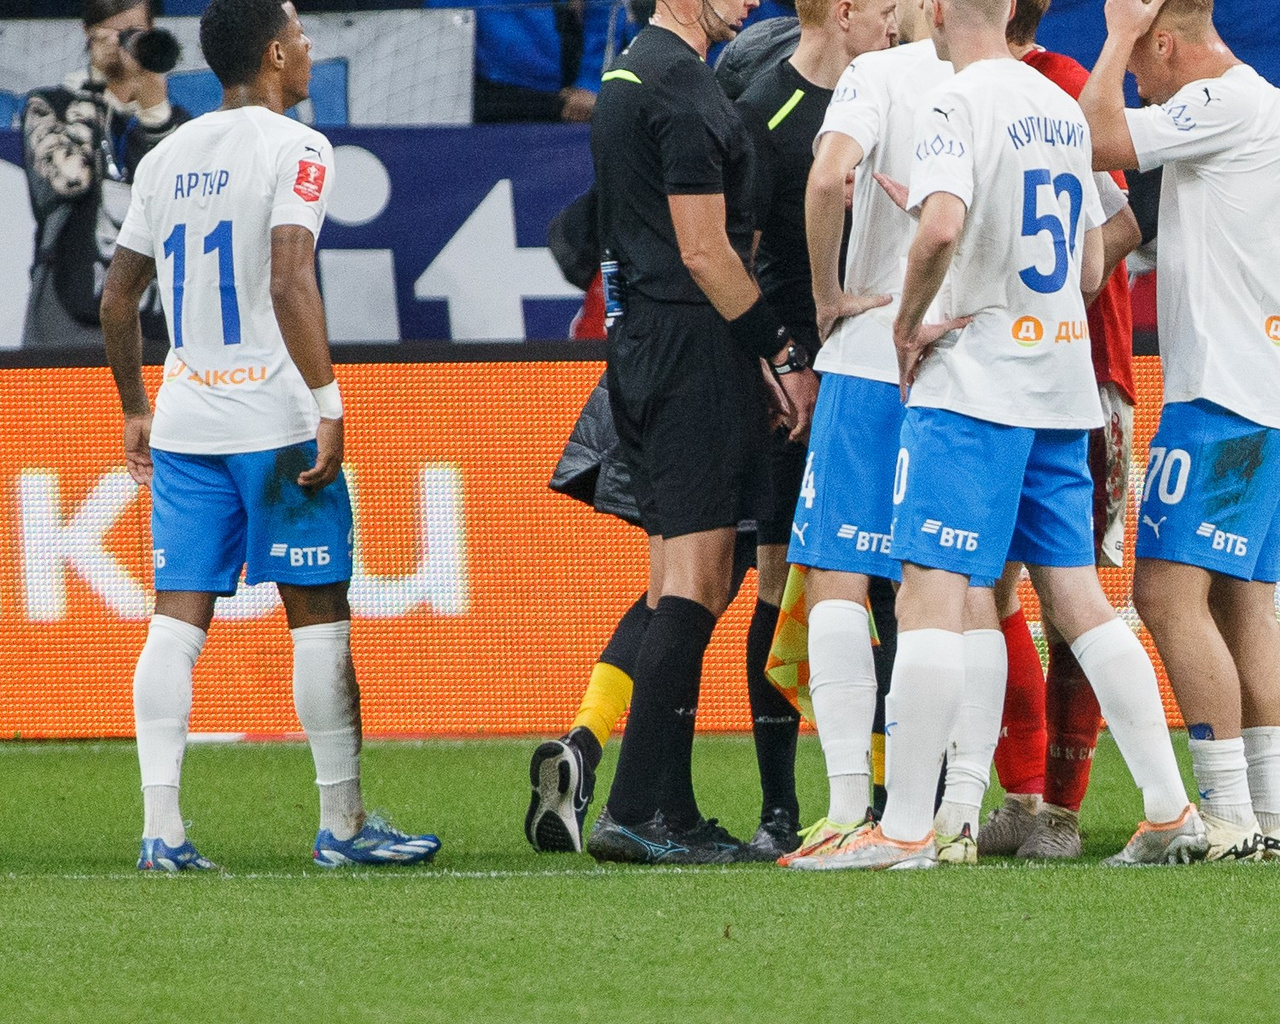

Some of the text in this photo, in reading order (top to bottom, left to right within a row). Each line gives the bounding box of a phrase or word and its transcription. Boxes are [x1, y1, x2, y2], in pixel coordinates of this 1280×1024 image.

[174, 170, 230, 200] АРТУР
[163, 220, 241, 349] 11
[800, 451, 816, 509] 4
[1143, 446, 1192, 505] 70
[855, 531, 892, 554] ВТБ
[940, 527, 979, 552] ВТБ
[1212, 532, 1249, 557] ВТБ
[290, 546, 331, 567] ВТБ
